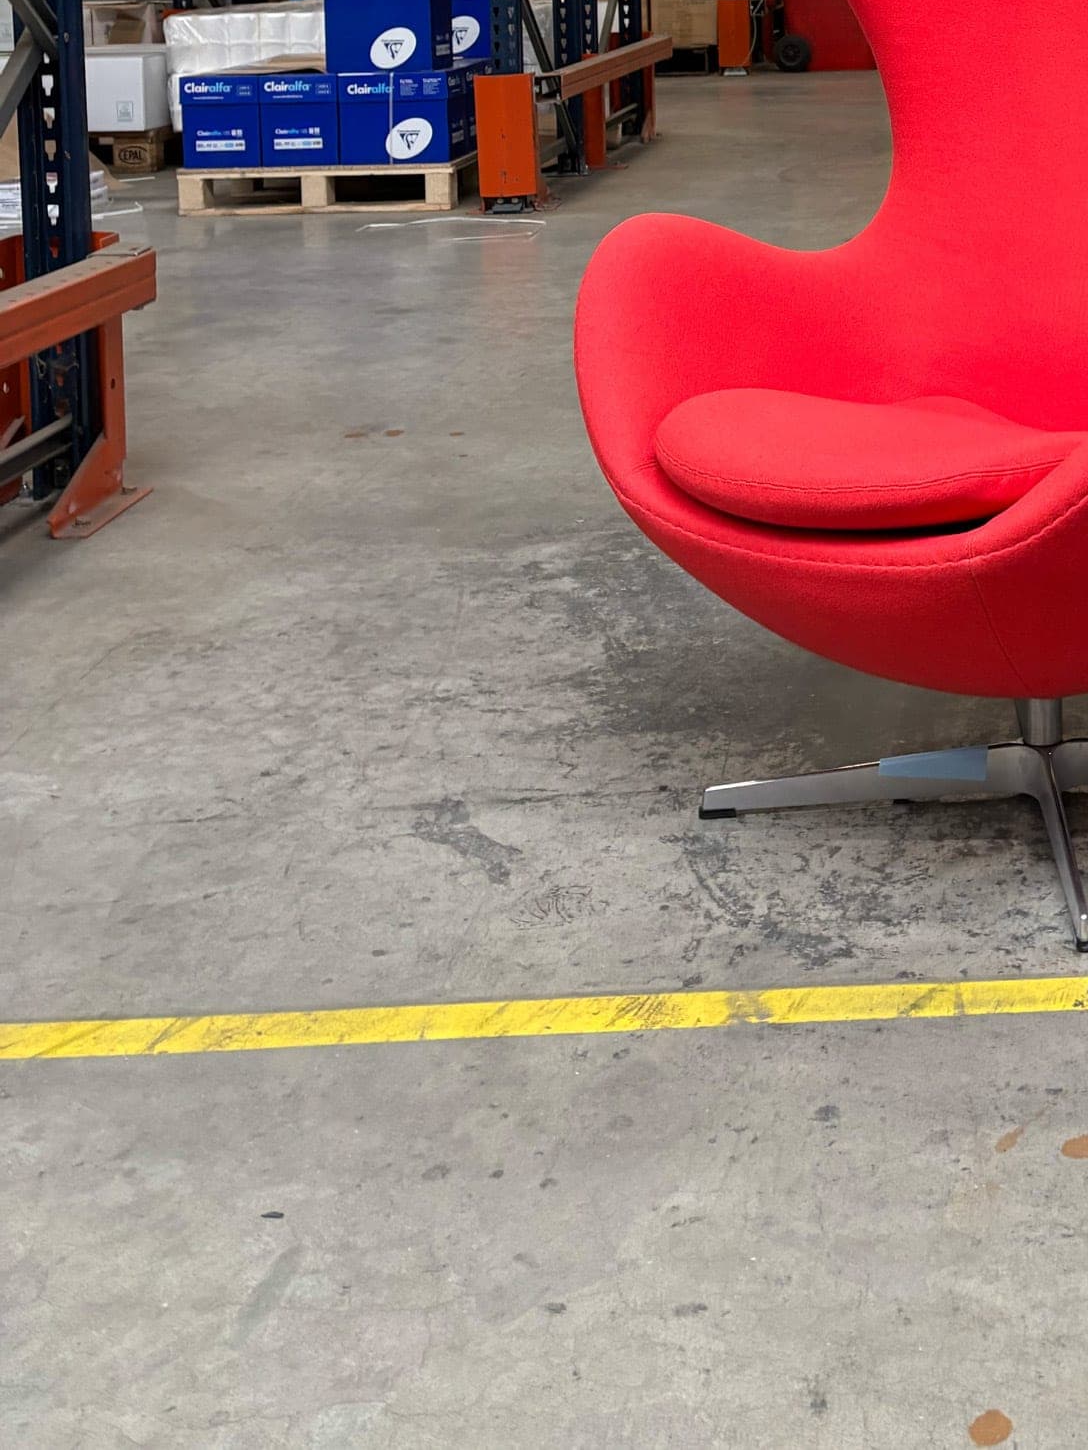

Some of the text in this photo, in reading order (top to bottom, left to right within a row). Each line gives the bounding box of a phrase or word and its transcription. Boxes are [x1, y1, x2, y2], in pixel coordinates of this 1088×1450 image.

[184, 82, 232, 94] Clairalfa
[263, 80, 312, 93] Clairalfa
[122, 150, 143, 162] EPAL
